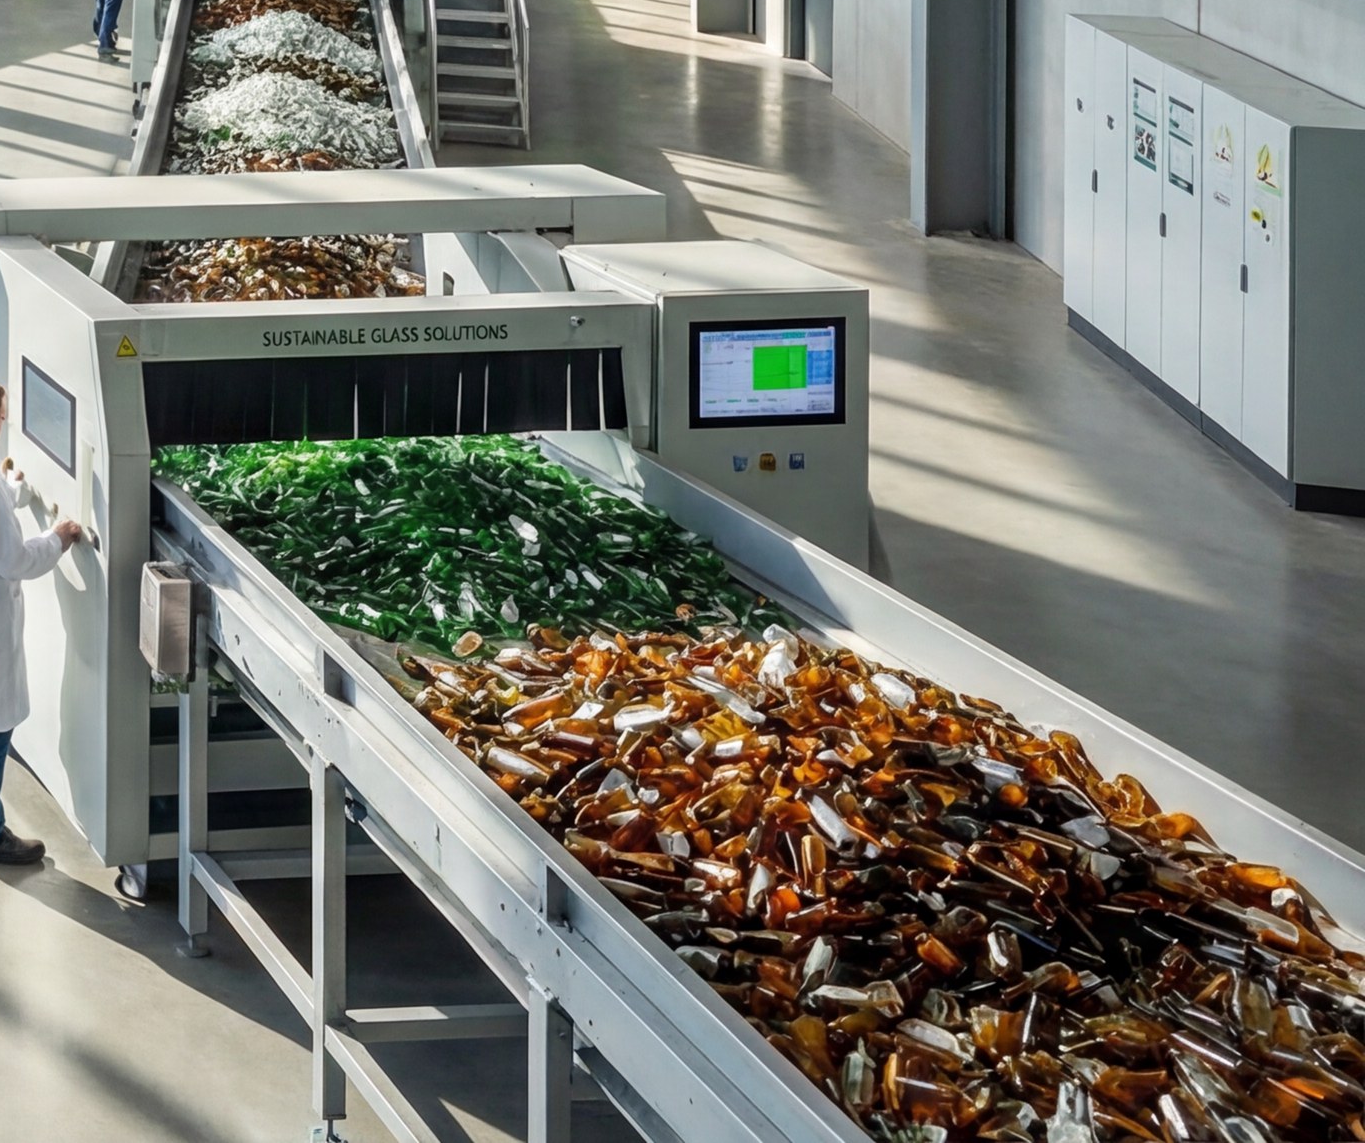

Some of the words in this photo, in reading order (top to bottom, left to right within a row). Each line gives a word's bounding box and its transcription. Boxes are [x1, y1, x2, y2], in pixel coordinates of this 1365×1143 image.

[262, 327, 366, 347] SUSTAINABLE
[370, 326, 420, 344] GLASS
[423, 323, 509, 343] SOLUTIONS
